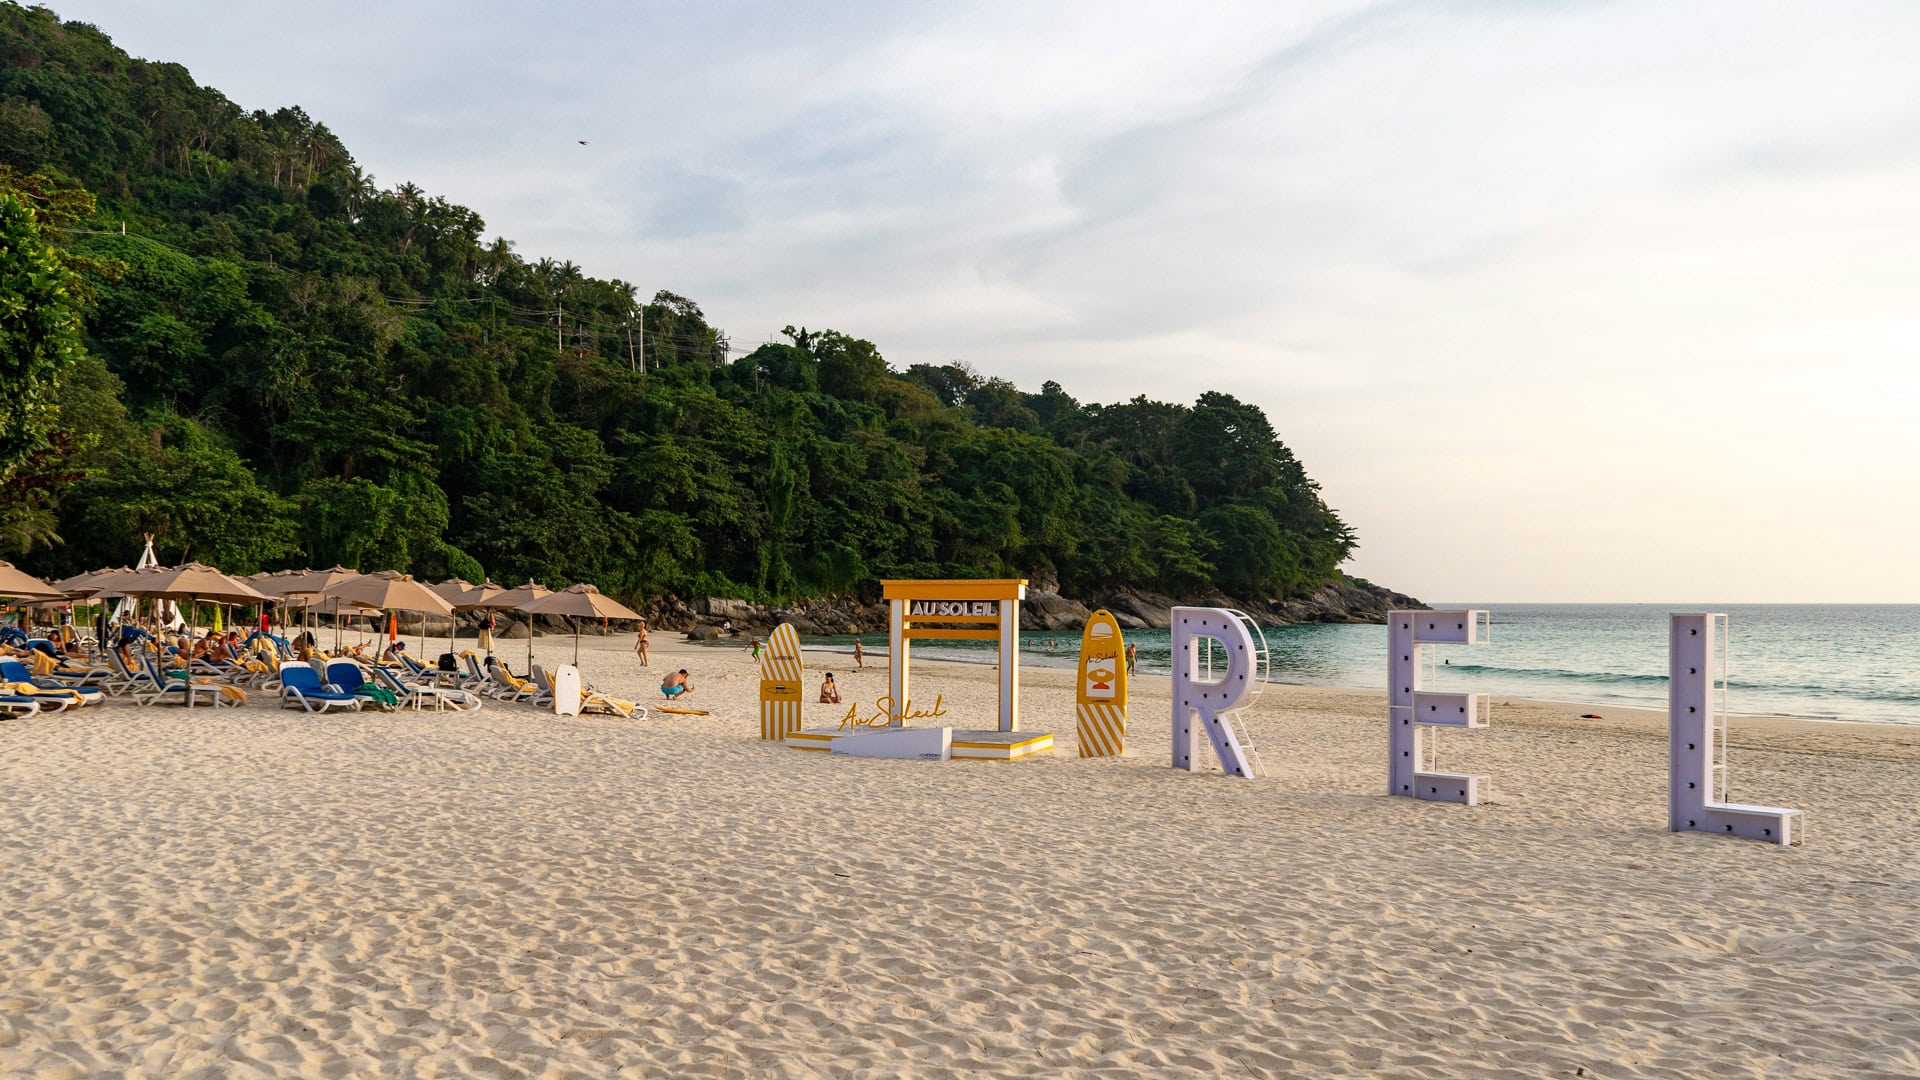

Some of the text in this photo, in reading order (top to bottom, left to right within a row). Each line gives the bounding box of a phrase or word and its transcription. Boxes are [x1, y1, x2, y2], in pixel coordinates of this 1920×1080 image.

[911, 601, 998, 616] AU SOLEIL
[838, 696, 947, 732] Au Soleil
